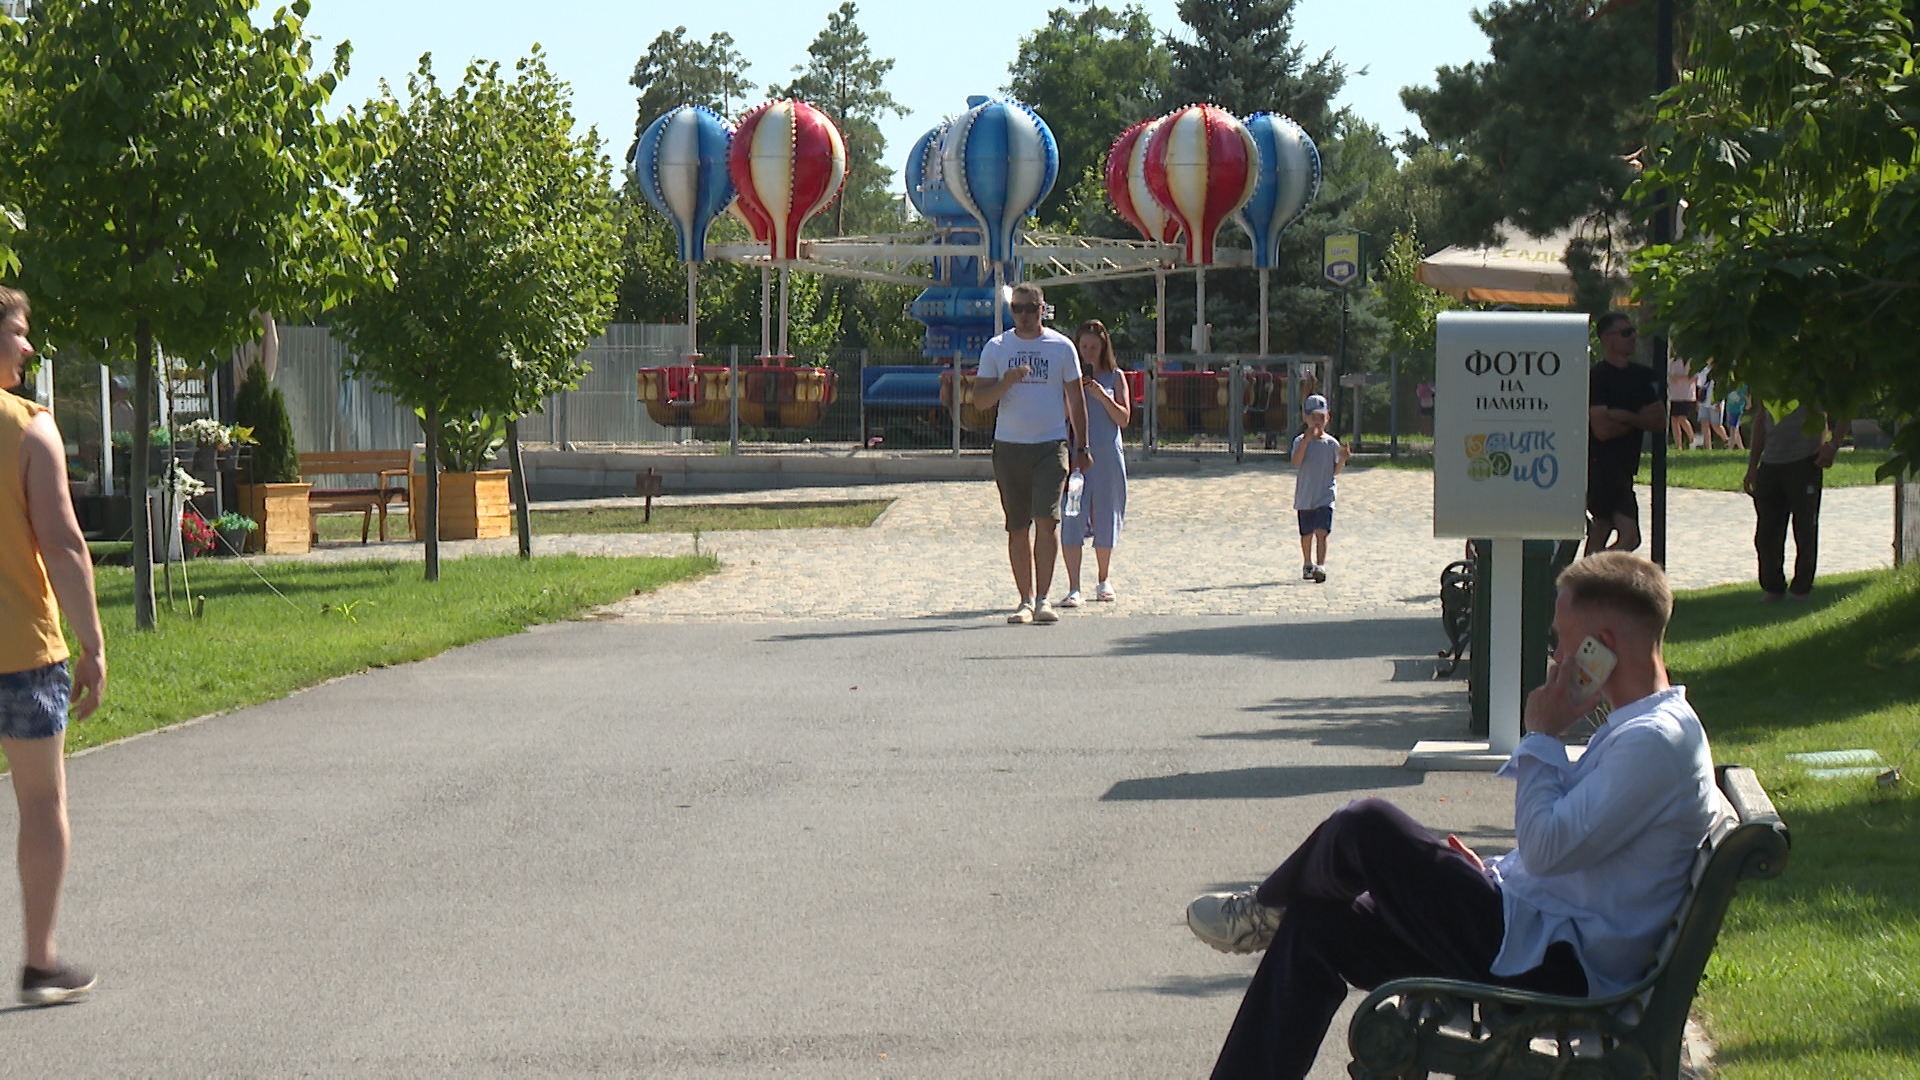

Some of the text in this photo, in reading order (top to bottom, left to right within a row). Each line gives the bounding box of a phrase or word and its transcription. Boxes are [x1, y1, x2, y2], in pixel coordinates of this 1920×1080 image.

[1008, 355, 1049, 369] CUSTOM
[1465, 349, 1561, 376] ФОТО
[1500, 379, 1524, 392] НА
[1476, 397, 1549, 411] ПАМЯТЬ
